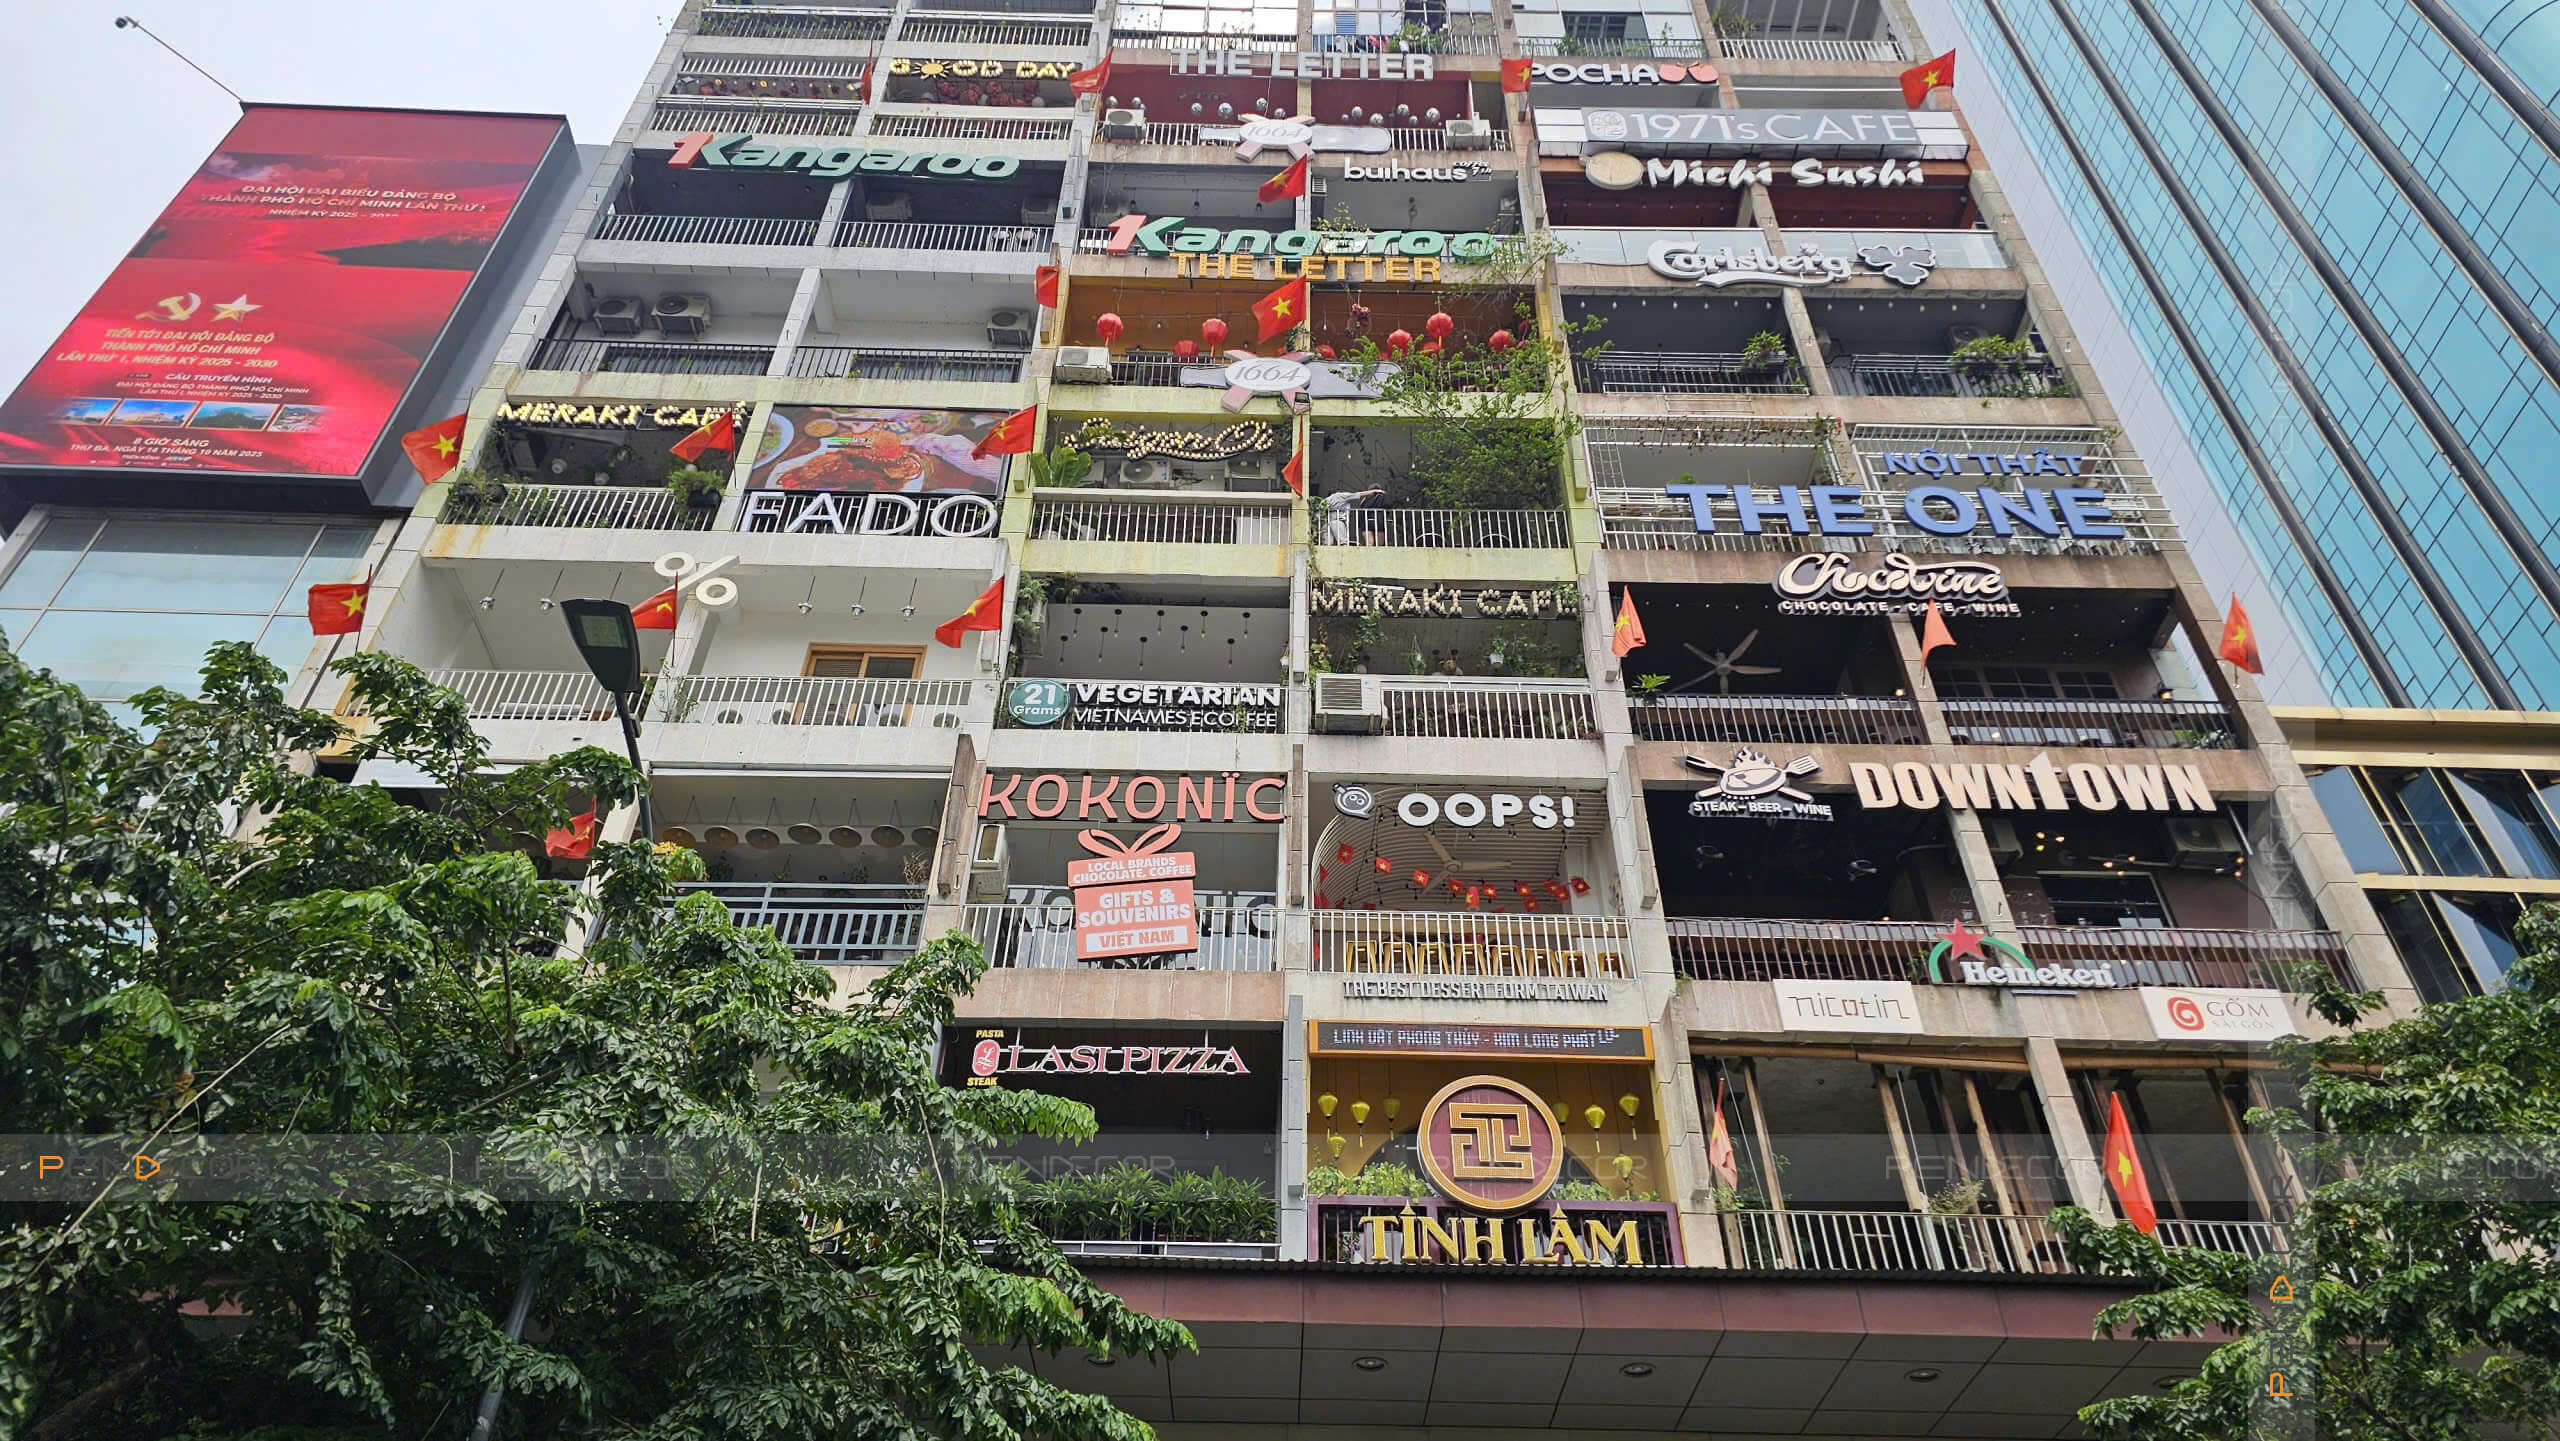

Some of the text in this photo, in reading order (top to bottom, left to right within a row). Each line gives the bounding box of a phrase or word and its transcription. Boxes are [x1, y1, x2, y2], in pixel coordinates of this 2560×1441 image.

[1015, 60, 1077, 80] DAY
[1171, 49, 1434, 80] THE LETTER
[1247, 126, 1302, 140] 1664
[1765, 114, 1918, 141] CAFE
[1647, 157, 1924, 188] Michi Sushi
[1170, 251, 1442, 283] THE LETTER
[1647, 240, 1853, 286] Carlsberg
[1233, 364, 1301, 382] 1664
[496, 402, 642, 425] MERAKI
[1883, 447, 1961, 479] NỘI
[740, 491, 999, 538] FADO
[1666, 483, 2125, 538] THE ONE
[1310, 583, 1463, 617] MERAKI
[1781, 600, 1890, 614] CHOCOLATE
[1971, 603, 2021, 616] WINE
[1023, 683, 1057, 705] 21
[1074, 683, 1281, 706] VEGETARIAN
[1013, 705, 1062, 716] Grams
[1397, 792, 1576, 829] OOPS!
[1087, 856, 1177, 873] LOCAL BRANDS
[1149, 864, 1193, 877] COFFEE
[1099, 887, 1176, 909] GIFTS &
[1078, 903, 1192, 928] SOUVENIRS
[1138, 929, 1175, 945] NAM
[1960, 960, 2115, 989] Heineken
[1344, 981, 1377, 999] THE
[1377, 982, 1421, 1000] BEST
[1421, 982, 1494, 1001] DESSERT
[1540, 983, 1608, 1002] TAIWAN
[1787, 995, 1911, 1021] nicotin
[976, 1030, 1004, 1039] PASTA
[1007, 1044, 1251, 1074] LASI PIZZA
[967, 1076, 999, 1087] STEAK
[1518, 1202, 1644, 1266] LÂM
